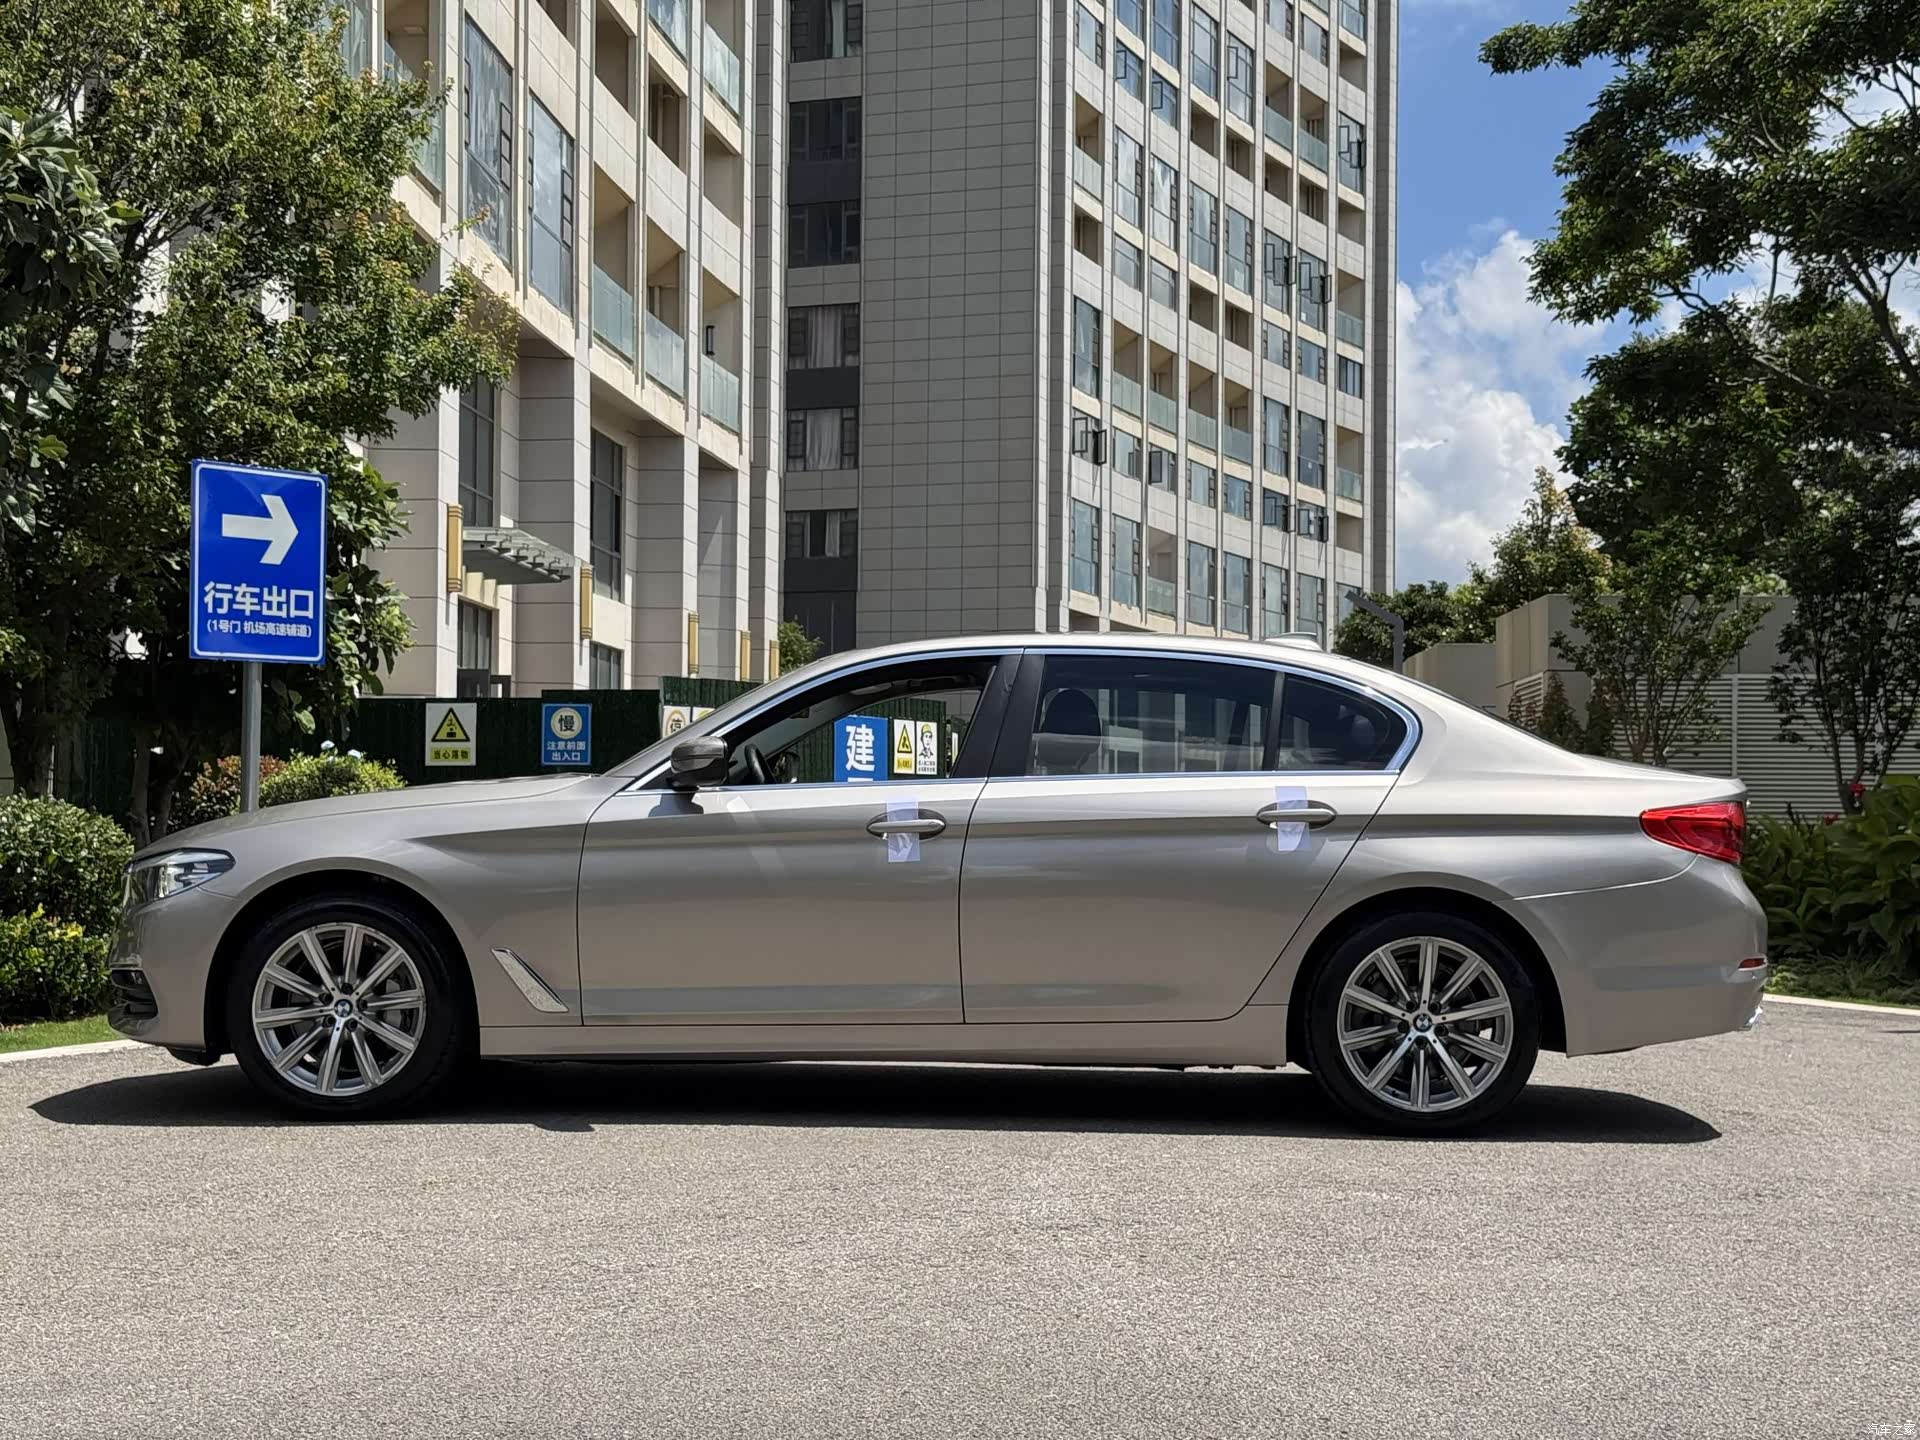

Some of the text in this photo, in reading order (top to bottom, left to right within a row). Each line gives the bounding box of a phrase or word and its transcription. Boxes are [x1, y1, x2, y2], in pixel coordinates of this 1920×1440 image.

[203, 581, 314, 619] 行车出口
[558, 714, 576, 732] 慢
[551, 751, 581, 761] 出入口
[845, 723, 875, 782] 建
